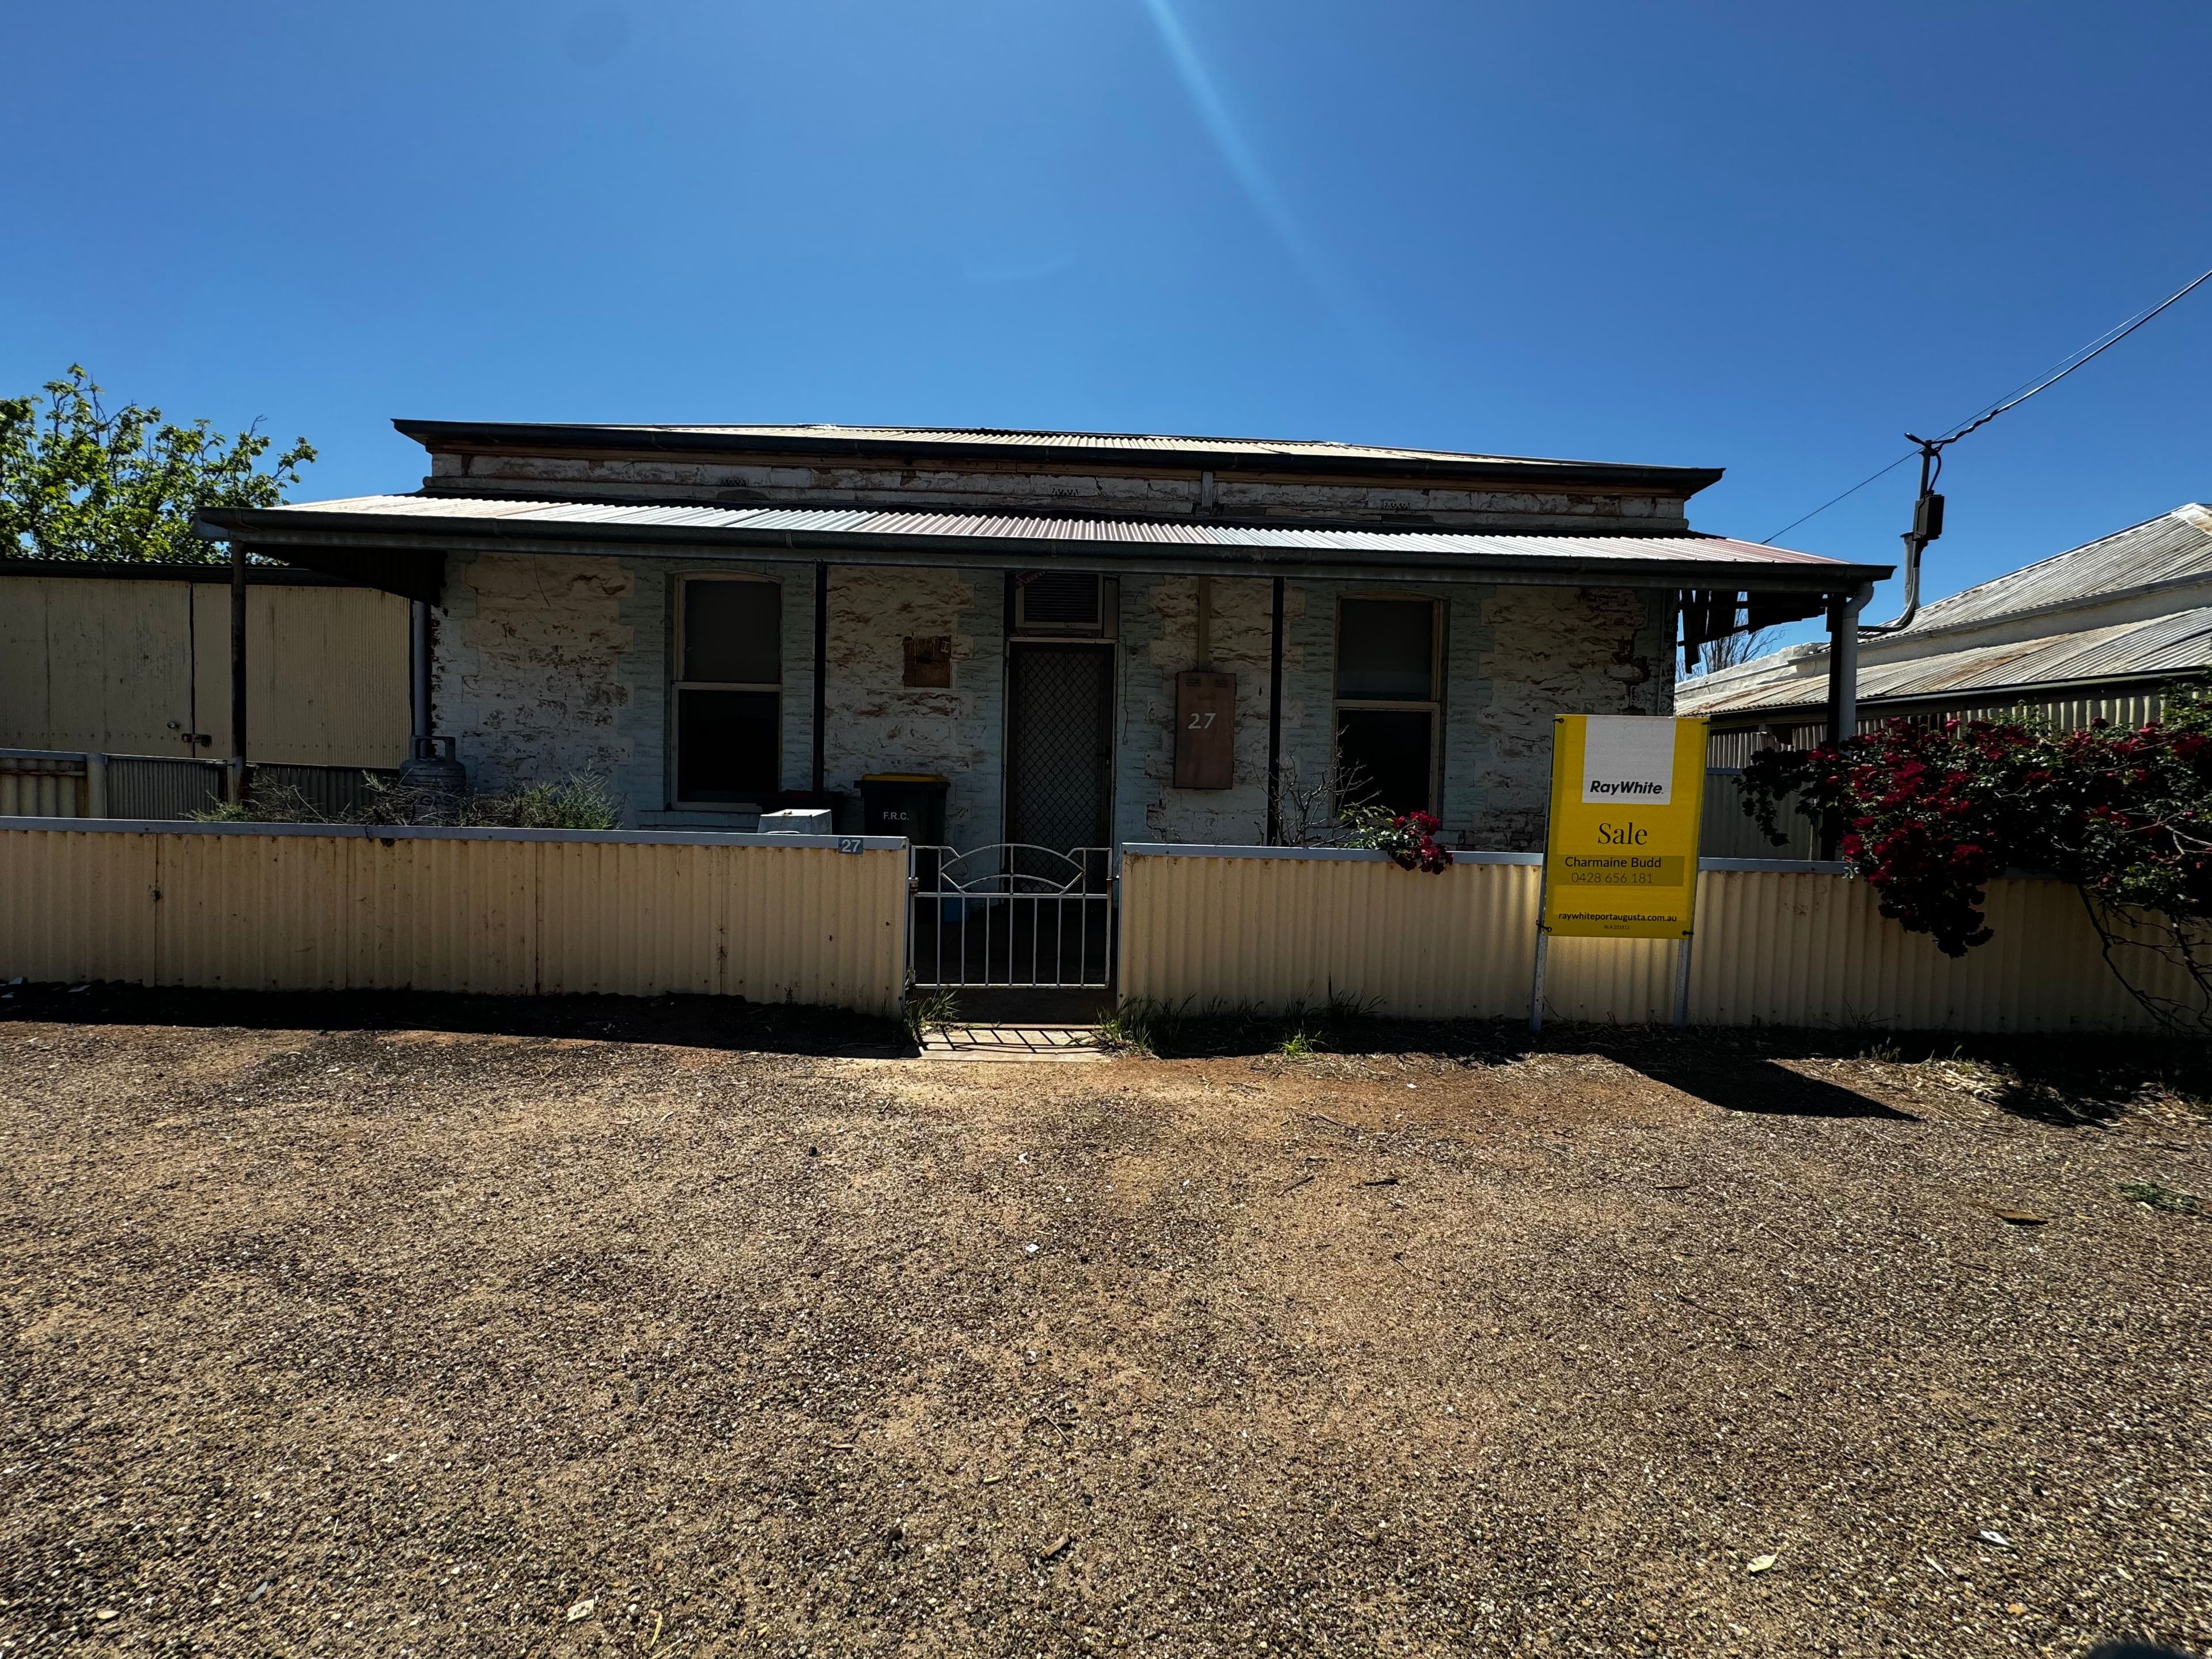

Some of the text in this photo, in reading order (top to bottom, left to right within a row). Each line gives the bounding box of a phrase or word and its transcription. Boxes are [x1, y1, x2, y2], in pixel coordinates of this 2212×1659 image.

[1188, 713, 1216, 729] 27
[884, 812, 910, 820] F.R.C.
[1597, 822, 1647, 845] Sale
[842, 839, 861, 853] 27
[1565, 857, 1661, 868] Charmaine Budd
[1571, 872, 1653, 884] 0428 656 181
[1558, 912, 1677, 922] raywhiteportaugusta.com.au
